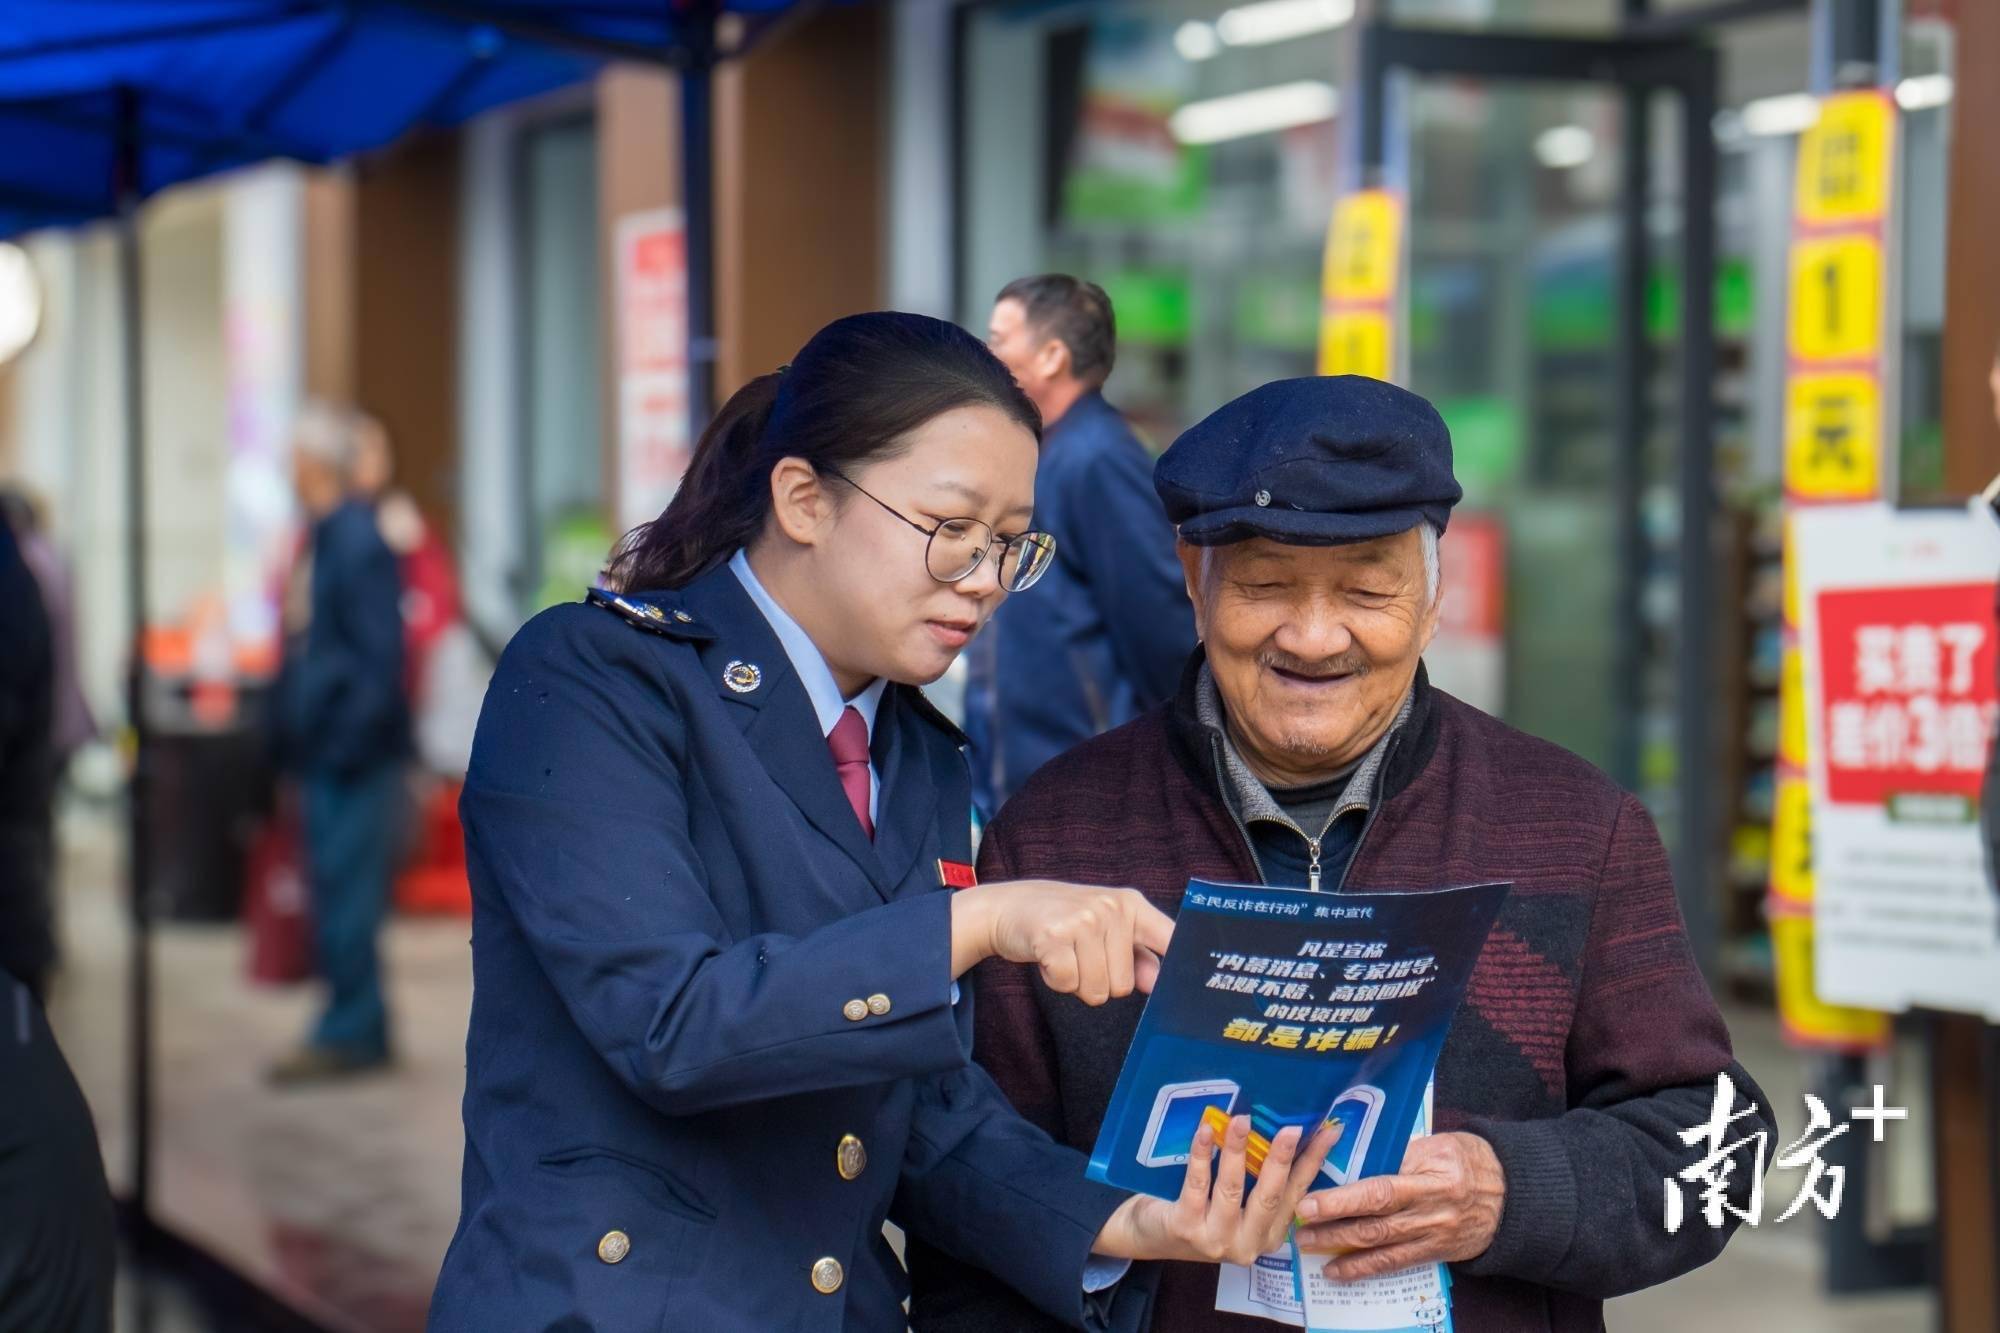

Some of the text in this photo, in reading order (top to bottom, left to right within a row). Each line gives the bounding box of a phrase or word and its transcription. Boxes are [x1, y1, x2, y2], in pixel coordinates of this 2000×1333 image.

[1297, 942, 1388, 958] 凡是宣称
[1264, 1004, 1375, 1023] 的投资理财
